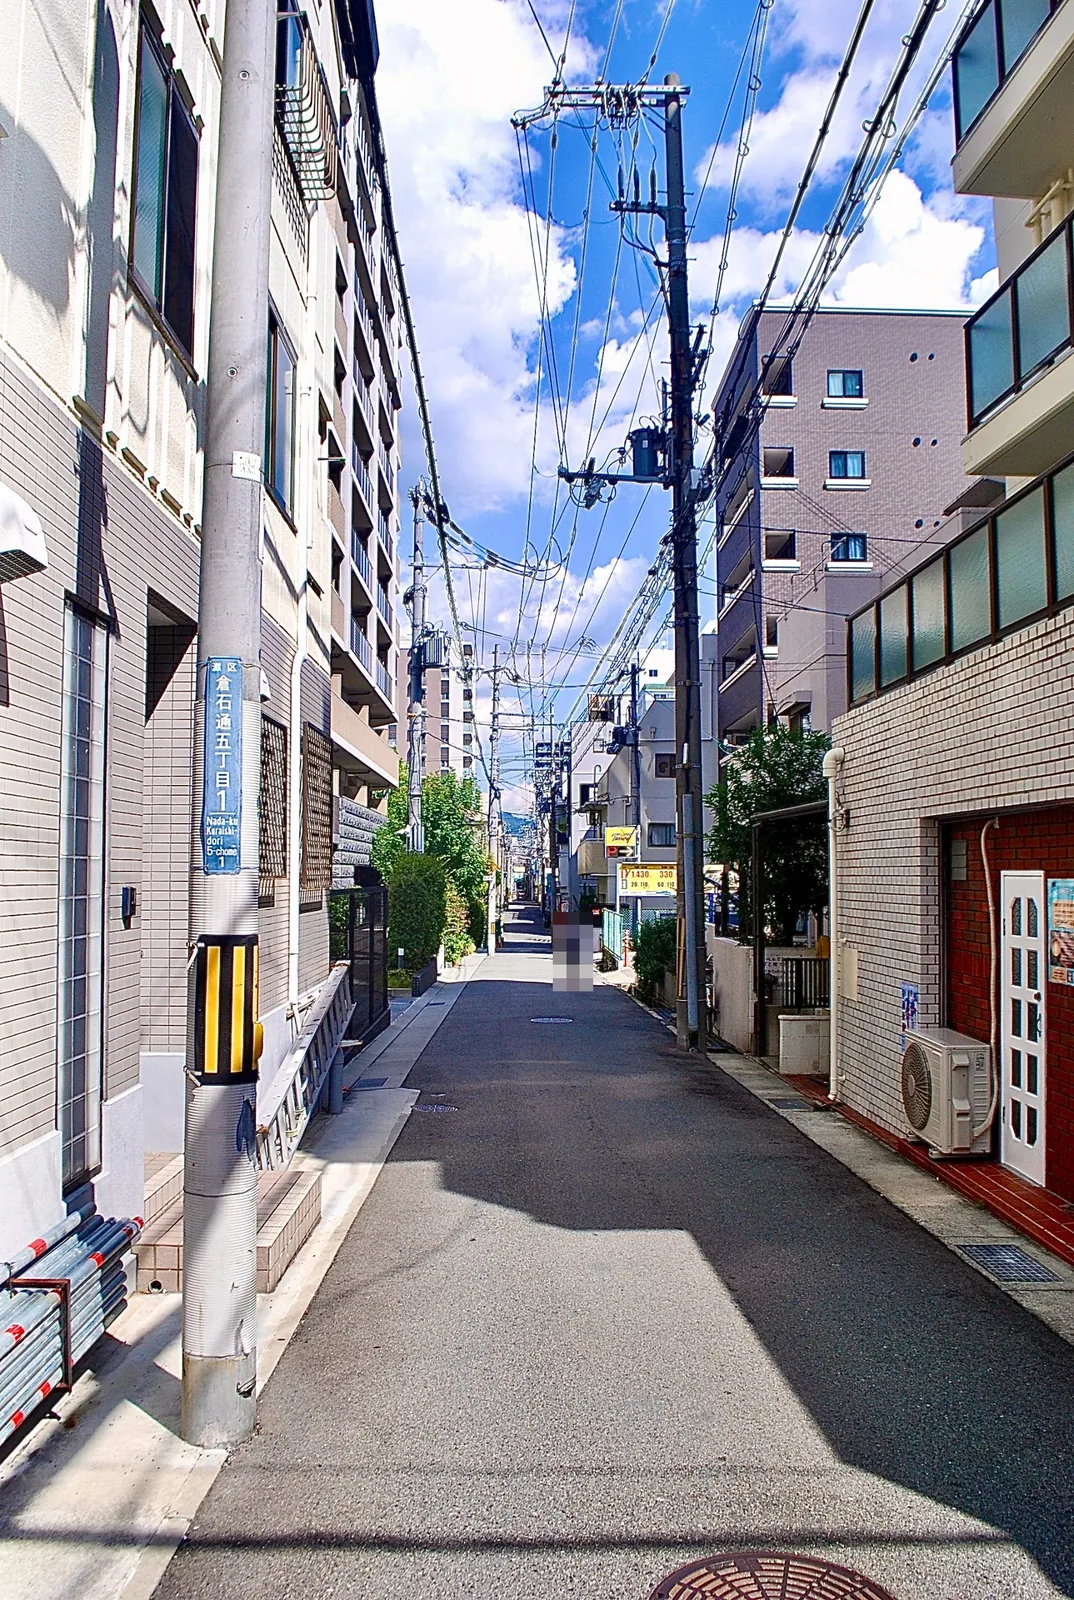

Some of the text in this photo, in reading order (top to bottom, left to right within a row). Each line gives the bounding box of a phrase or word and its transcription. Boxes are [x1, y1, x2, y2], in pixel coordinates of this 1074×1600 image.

[206, 816, 239, 826] Nada-ku
[206, 836, 224, 846] dori
[219, 856, 225, 868] 1
